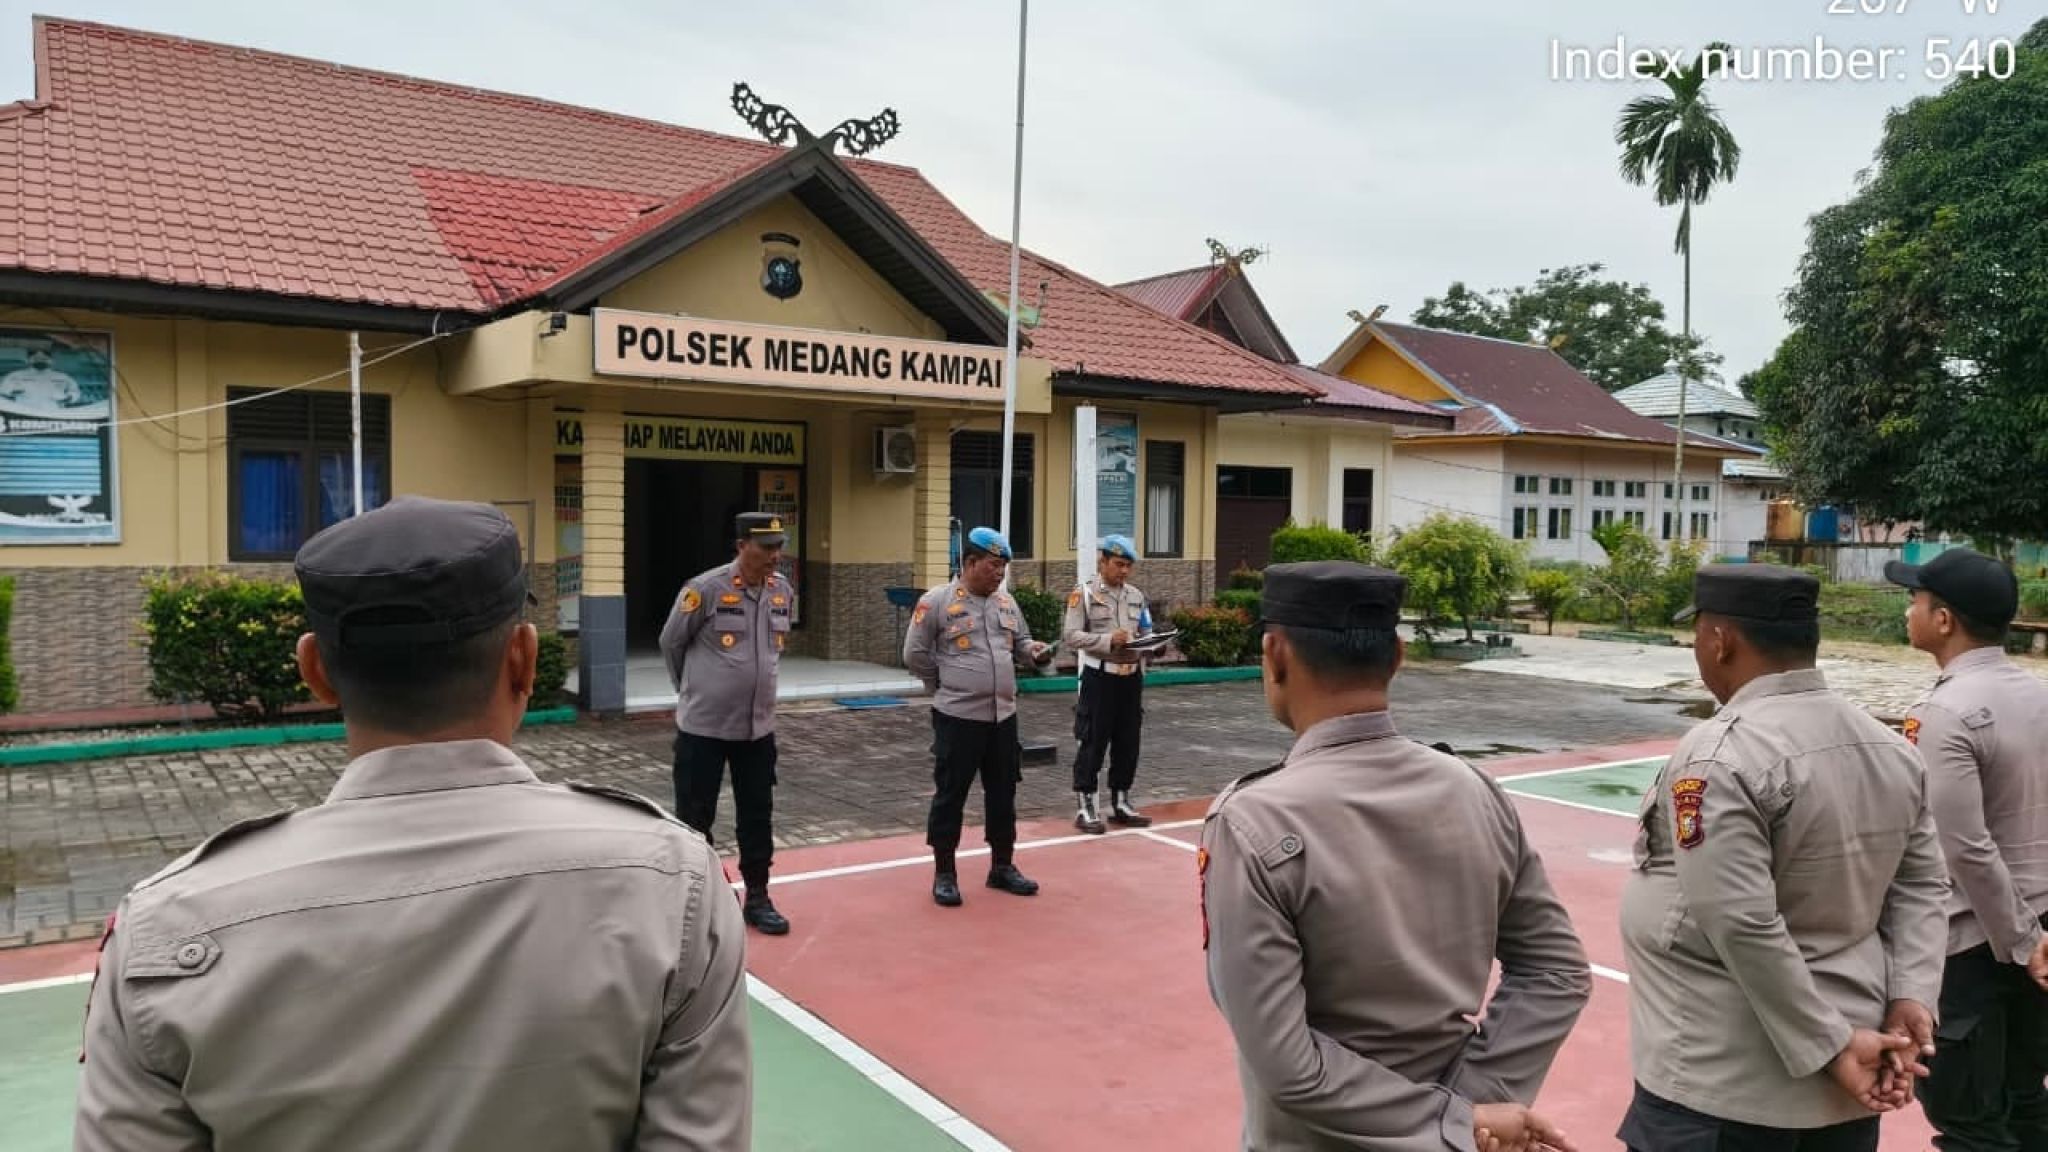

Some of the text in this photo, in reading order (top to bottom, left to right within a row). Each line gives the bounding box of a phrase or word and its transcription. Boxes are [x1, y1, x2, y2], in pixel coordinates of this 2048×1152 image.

[617, 324, 1001, 389] POLSEK MEDANG KAMPAI
[623, 422, 654, 449] IAP
[658, 424, 745, 453] MELAYANI
[751, 432, 795, 456] ANDA
